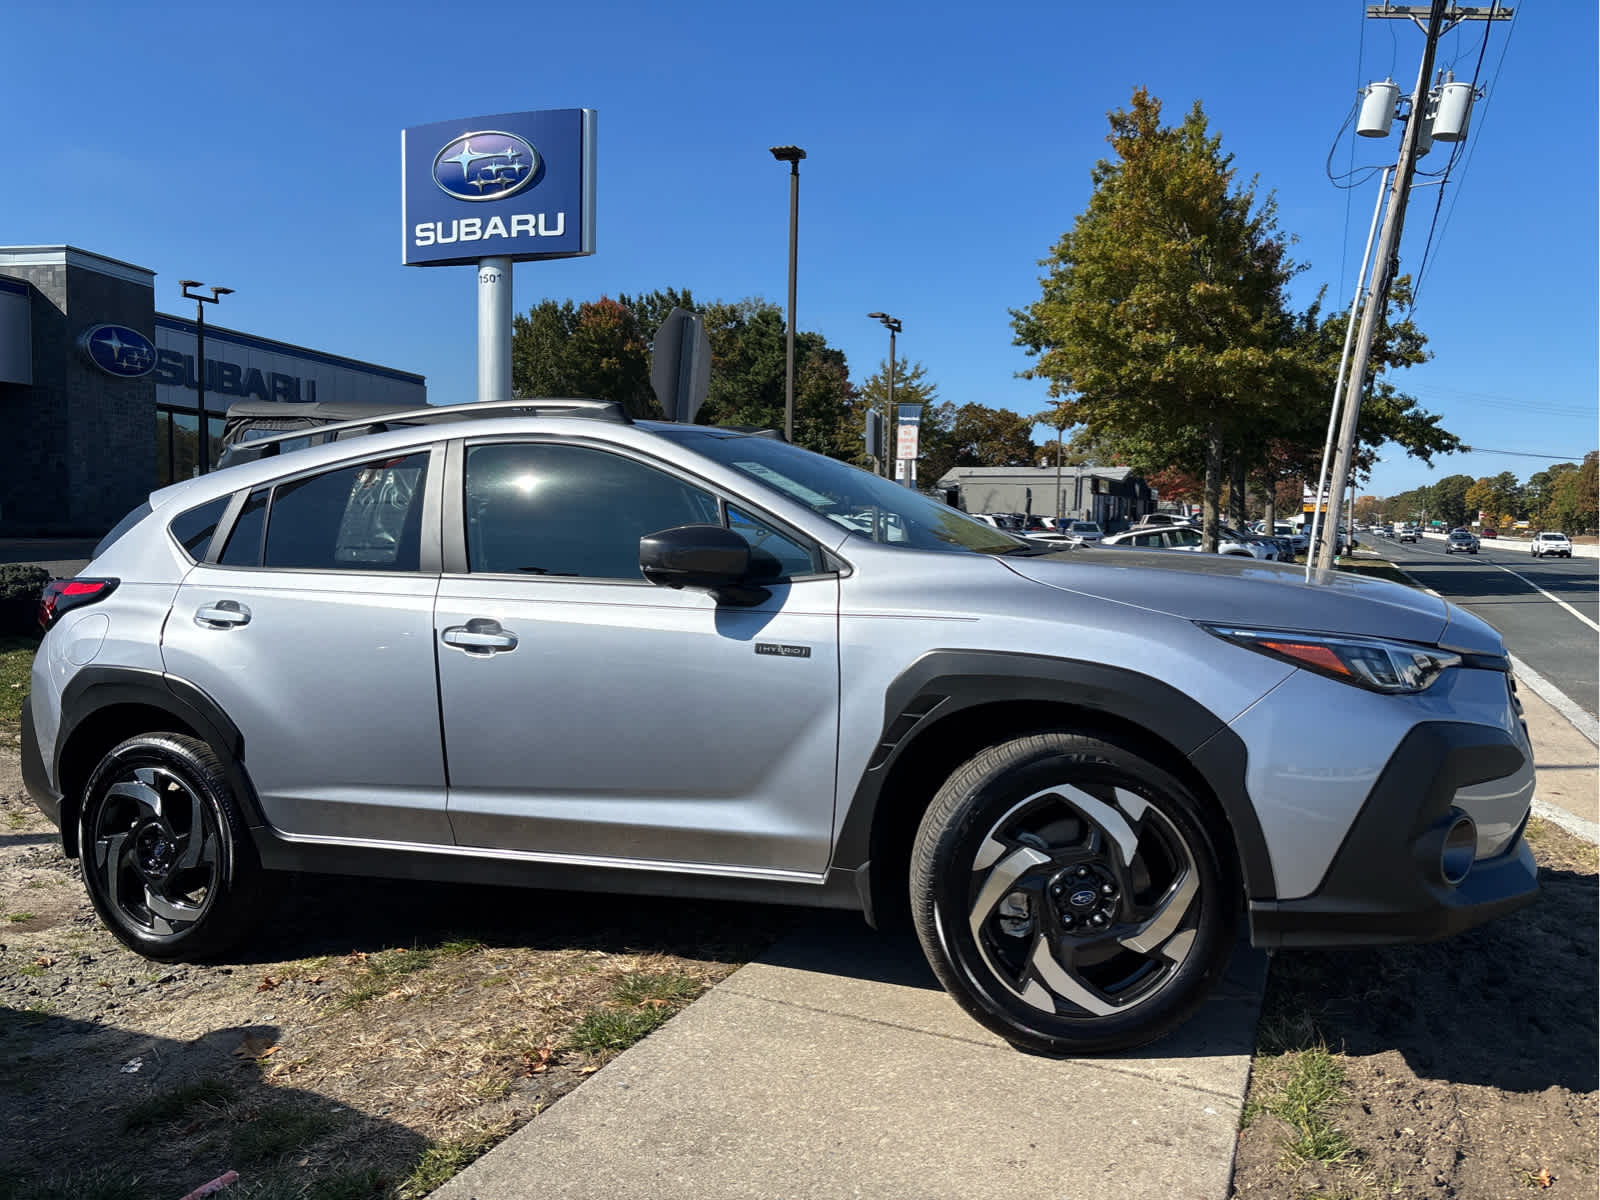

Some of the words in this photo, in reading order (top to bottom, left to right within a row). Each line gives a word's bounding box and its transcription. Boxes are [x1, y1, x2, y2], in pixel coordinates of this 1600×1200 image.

[415, 212, 565, 247] SUBARU
[152, 348, 317, 403] SUBARU
[762, 646, 801, 654] HYBRID
